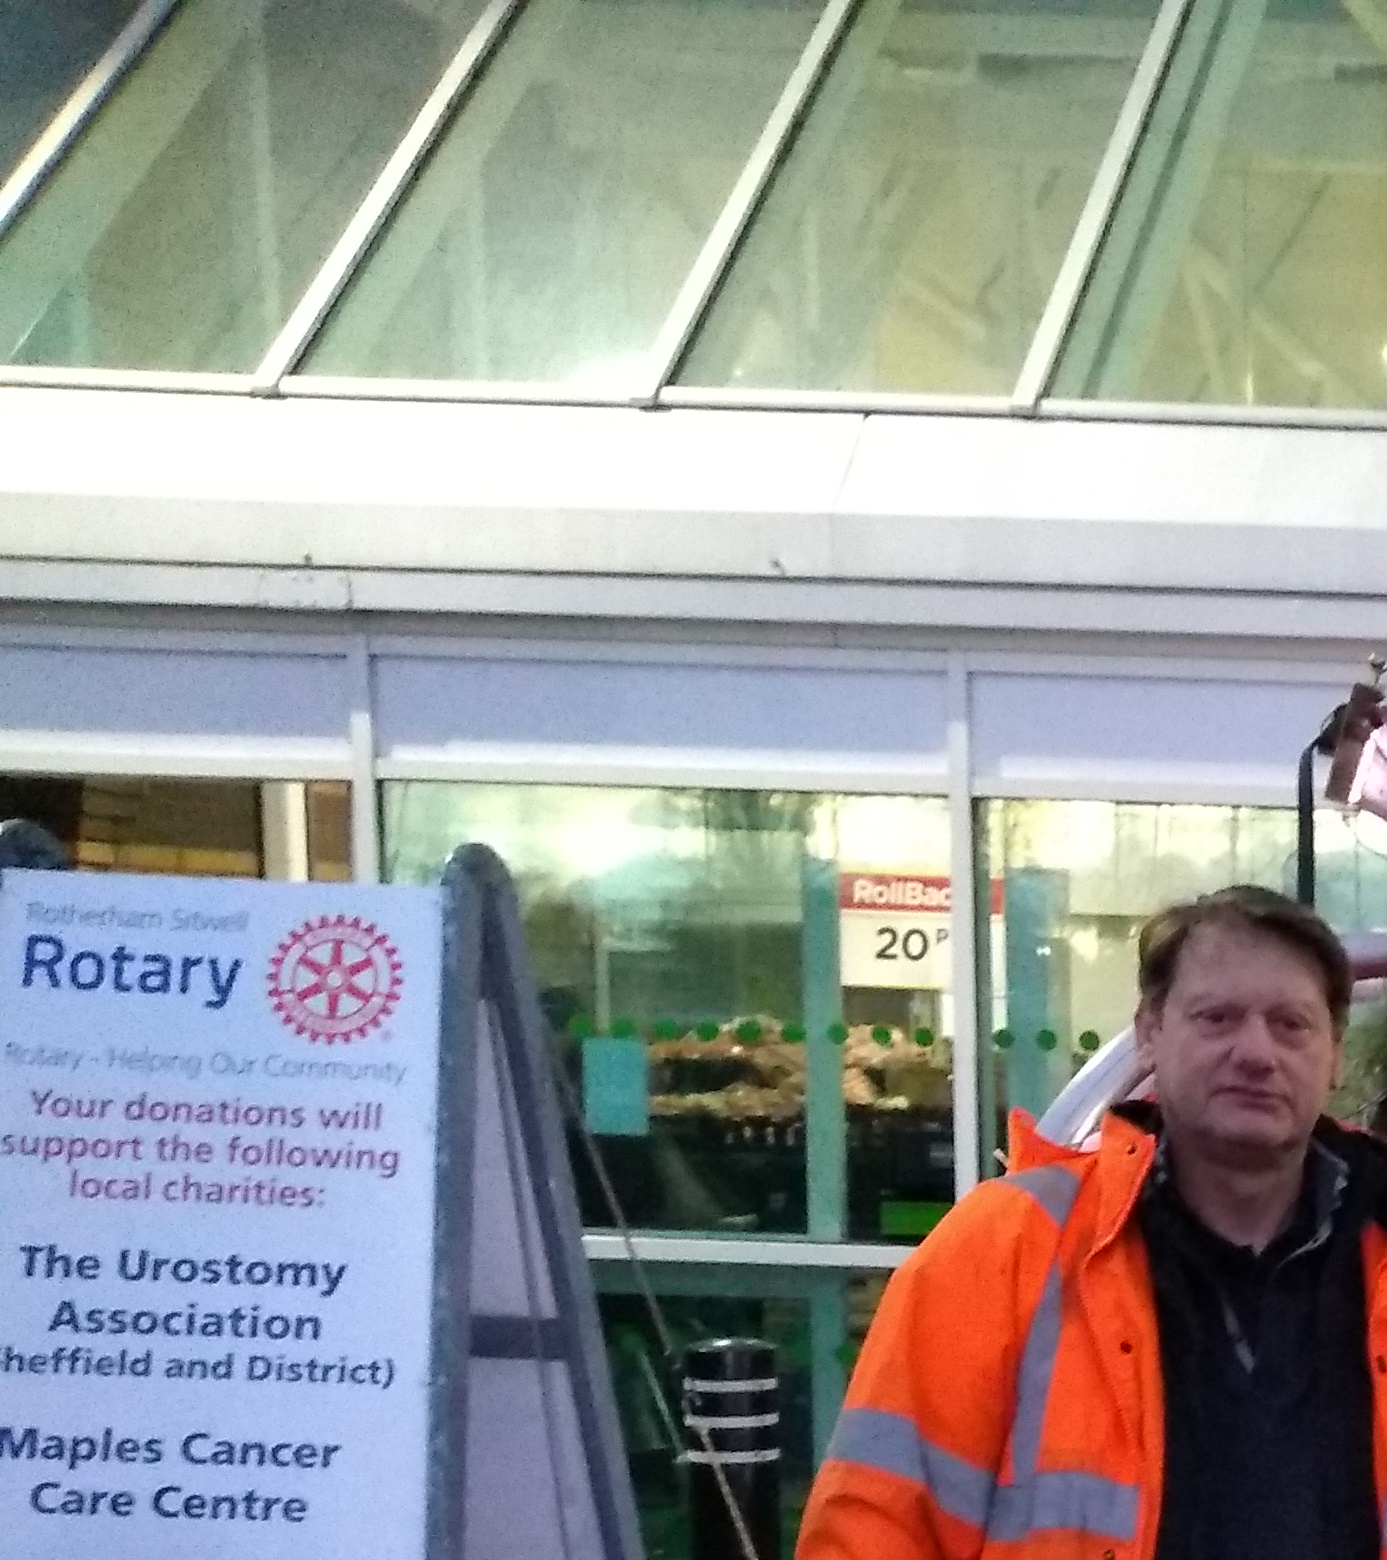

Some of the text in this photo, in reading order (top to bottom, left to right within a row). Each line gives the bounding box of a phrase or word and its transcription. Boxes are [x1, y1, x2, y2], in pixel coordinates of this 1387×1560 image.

[852, 878, 952, 907] RollBac
[26, 900, 162, 930] Rotherham
[22, 933, 244, 1009] Rotary
[5, 1041, 83, 1071] Rotary
[106, 1045, 202, 1080] Helping
[210, 1052, 257, 1076] Our
[264, 1053, 408, 1088] Community
[30, 1088, 383, 1131] Your donations will
[2, 1133, 400, 1179] support the following
[69, 1169, 326, 1208] local charities:
[19, 1243, 348, 1298] The Urostomy
[47, 1299, 323, 1341] Association
[0, 1345, 396, 1390] heffield and District)
[0, 1426, 341, 1470] Maples Cancer
[29, 1481, 309, 1523] Care Centre
